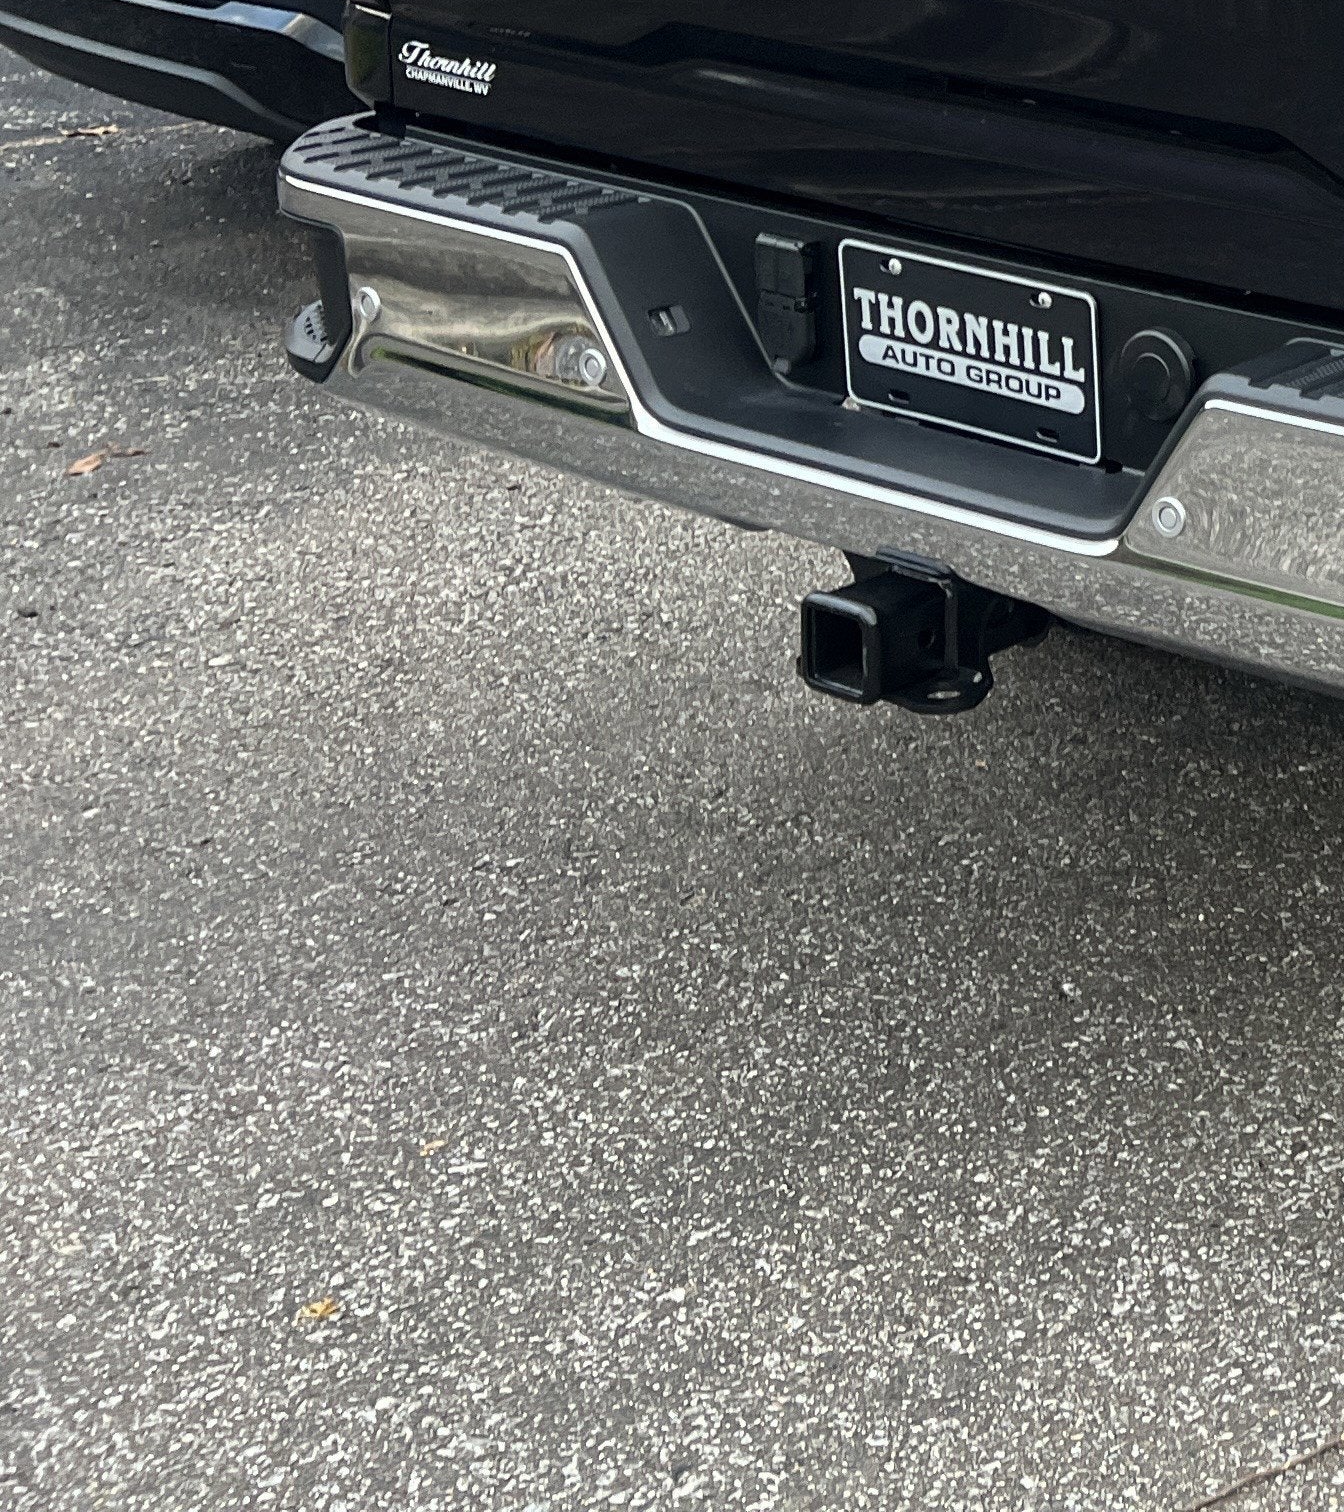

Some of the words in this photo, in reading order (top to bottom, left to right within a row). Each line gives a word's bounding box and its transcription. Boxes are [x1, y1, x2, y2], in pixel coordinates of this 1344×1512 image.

[398, 40, 497, 81] Thornhill
[853, 287, 1085, 382] THORNHILL
[882, 344, 955, 376] AUTO
[966, 364, 1061, 402] GROUP
